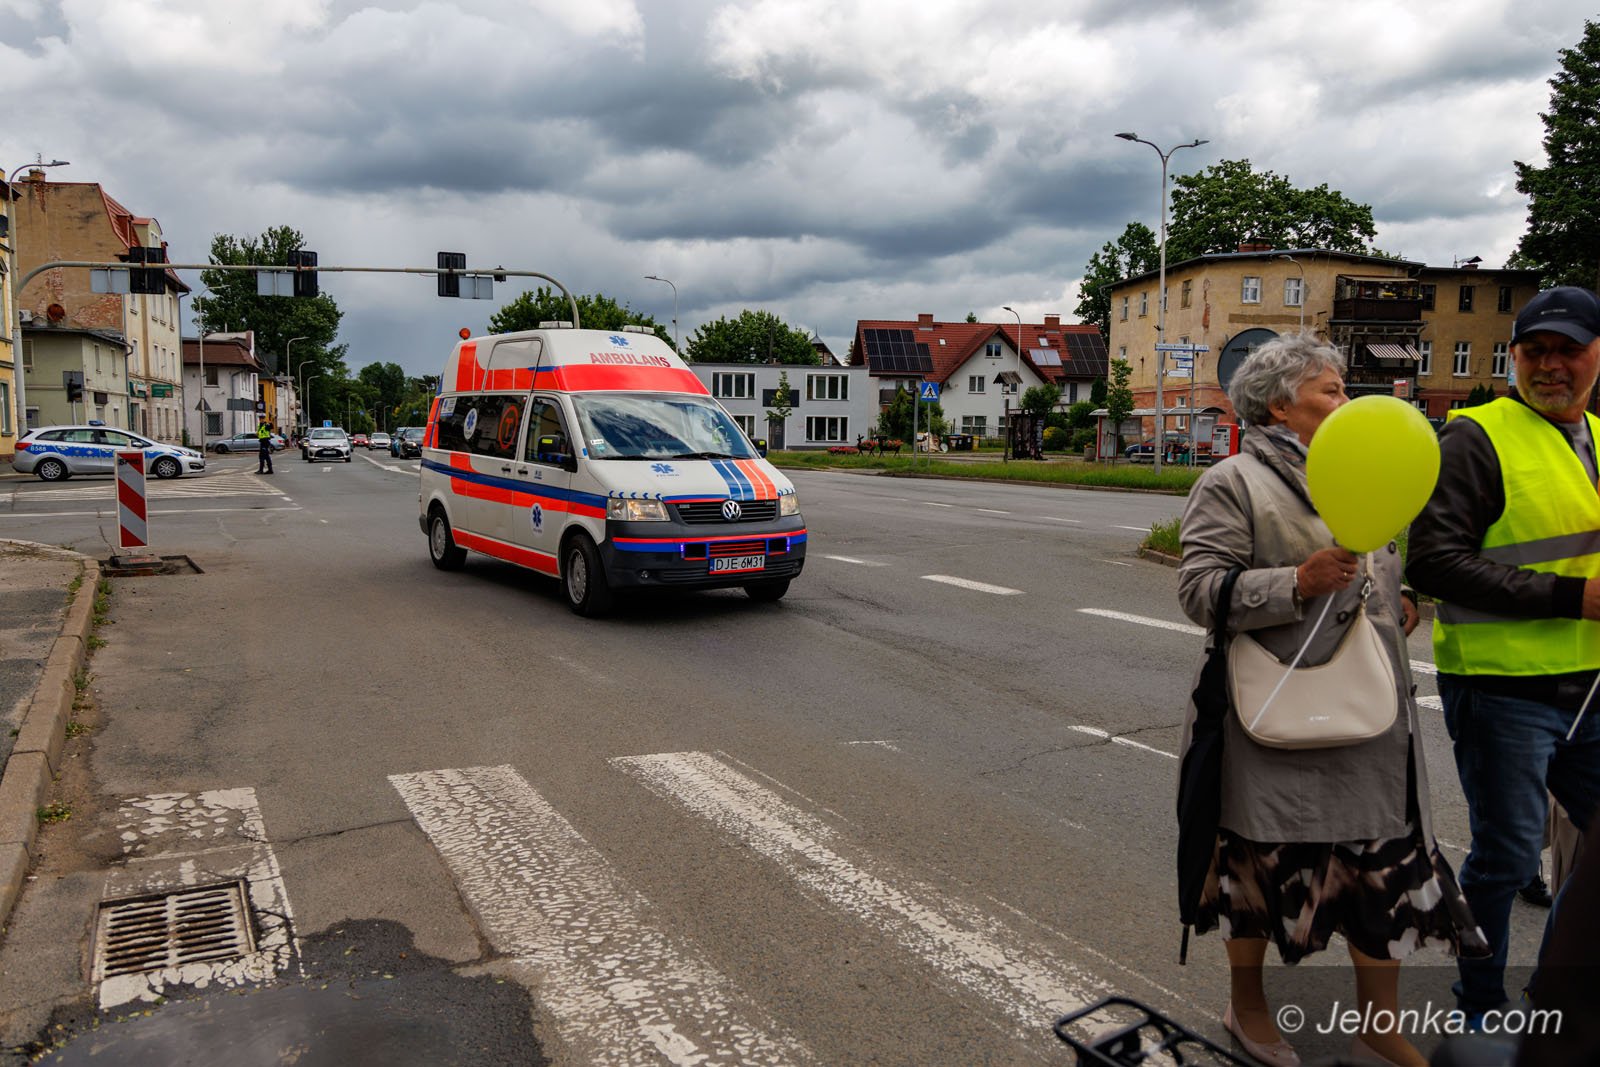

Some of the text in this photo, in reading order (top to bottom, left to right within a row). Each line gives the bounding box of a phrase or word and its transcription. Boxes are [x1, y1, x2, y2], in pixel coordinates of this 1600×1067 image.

[589, 352, 671, 368] AMBULANS
[716, 556, 763, 570] DJE 6M31
